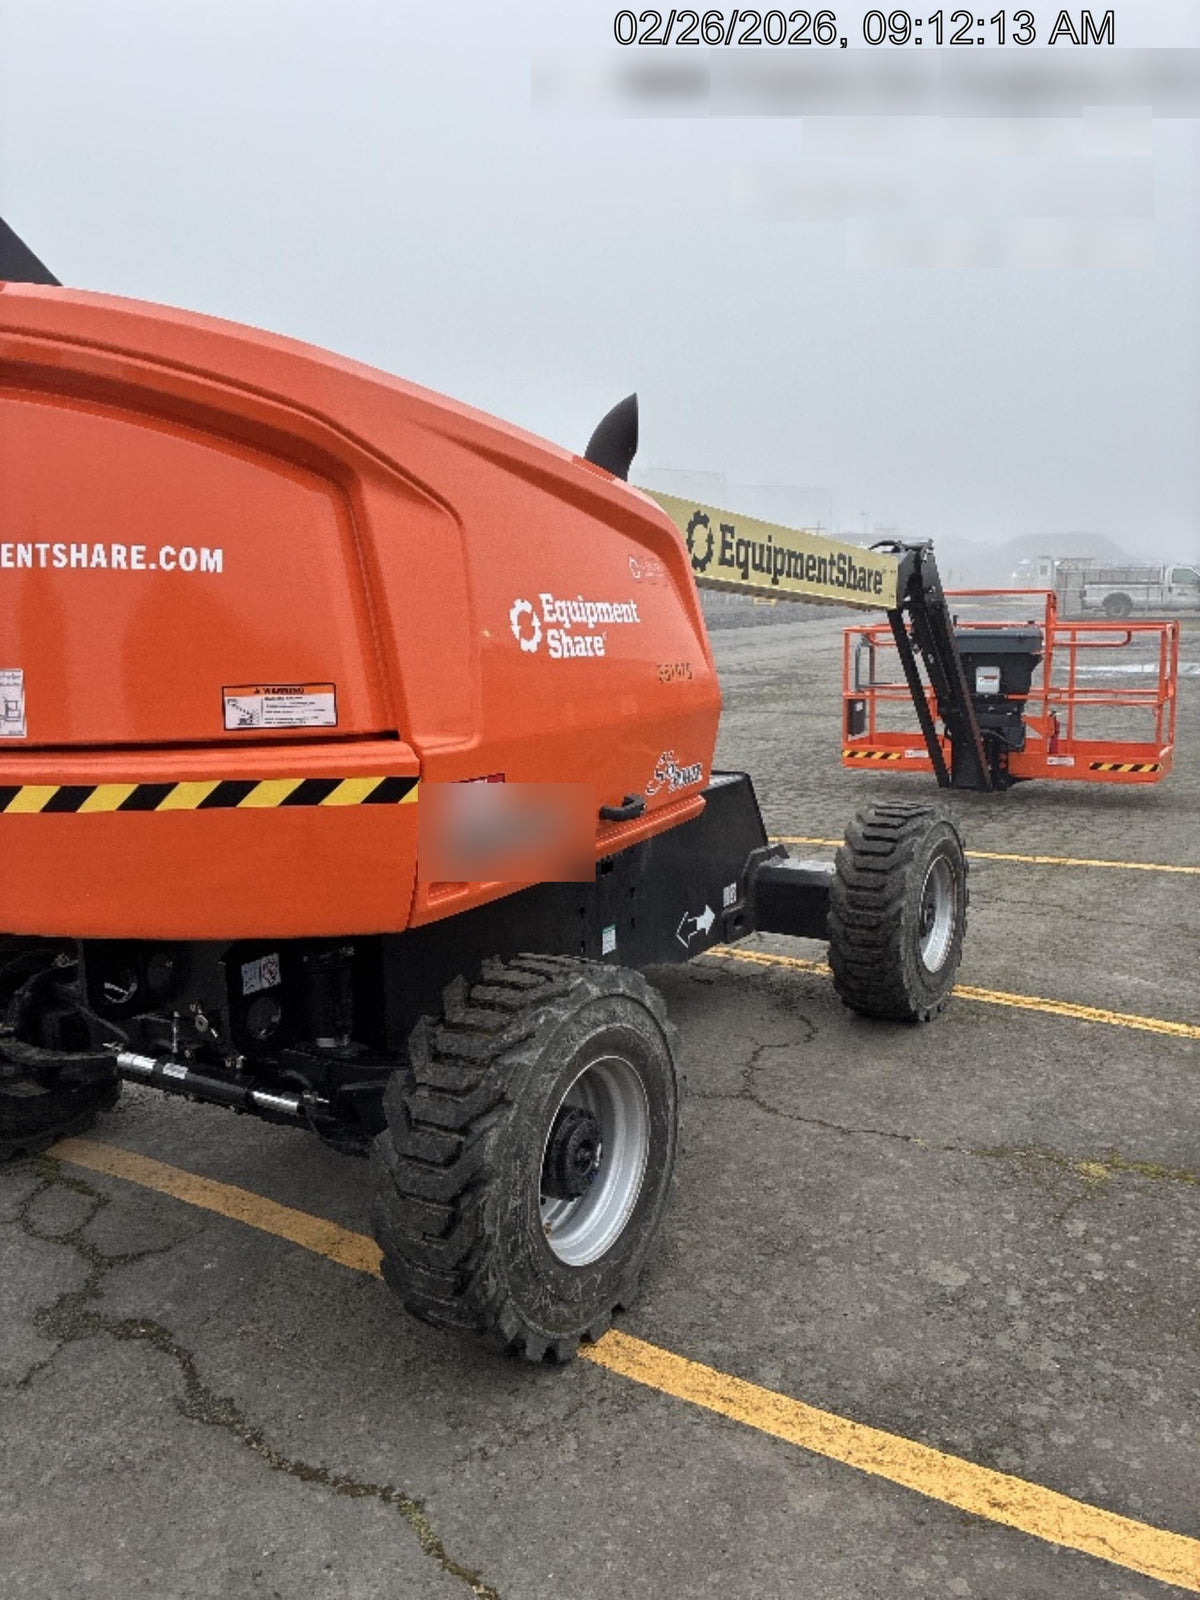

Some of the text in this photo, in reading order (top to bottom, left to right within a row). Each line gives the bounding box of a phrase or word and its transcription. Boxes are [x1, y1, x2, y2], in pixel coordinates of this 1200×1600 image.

[0, 543, 224, 573] ENTSHARE.COM
[718, 522, 884, 594] EquipmentShare
[539, 593, 641, 628] Equipment
[547, 629, 606, 659] Share
